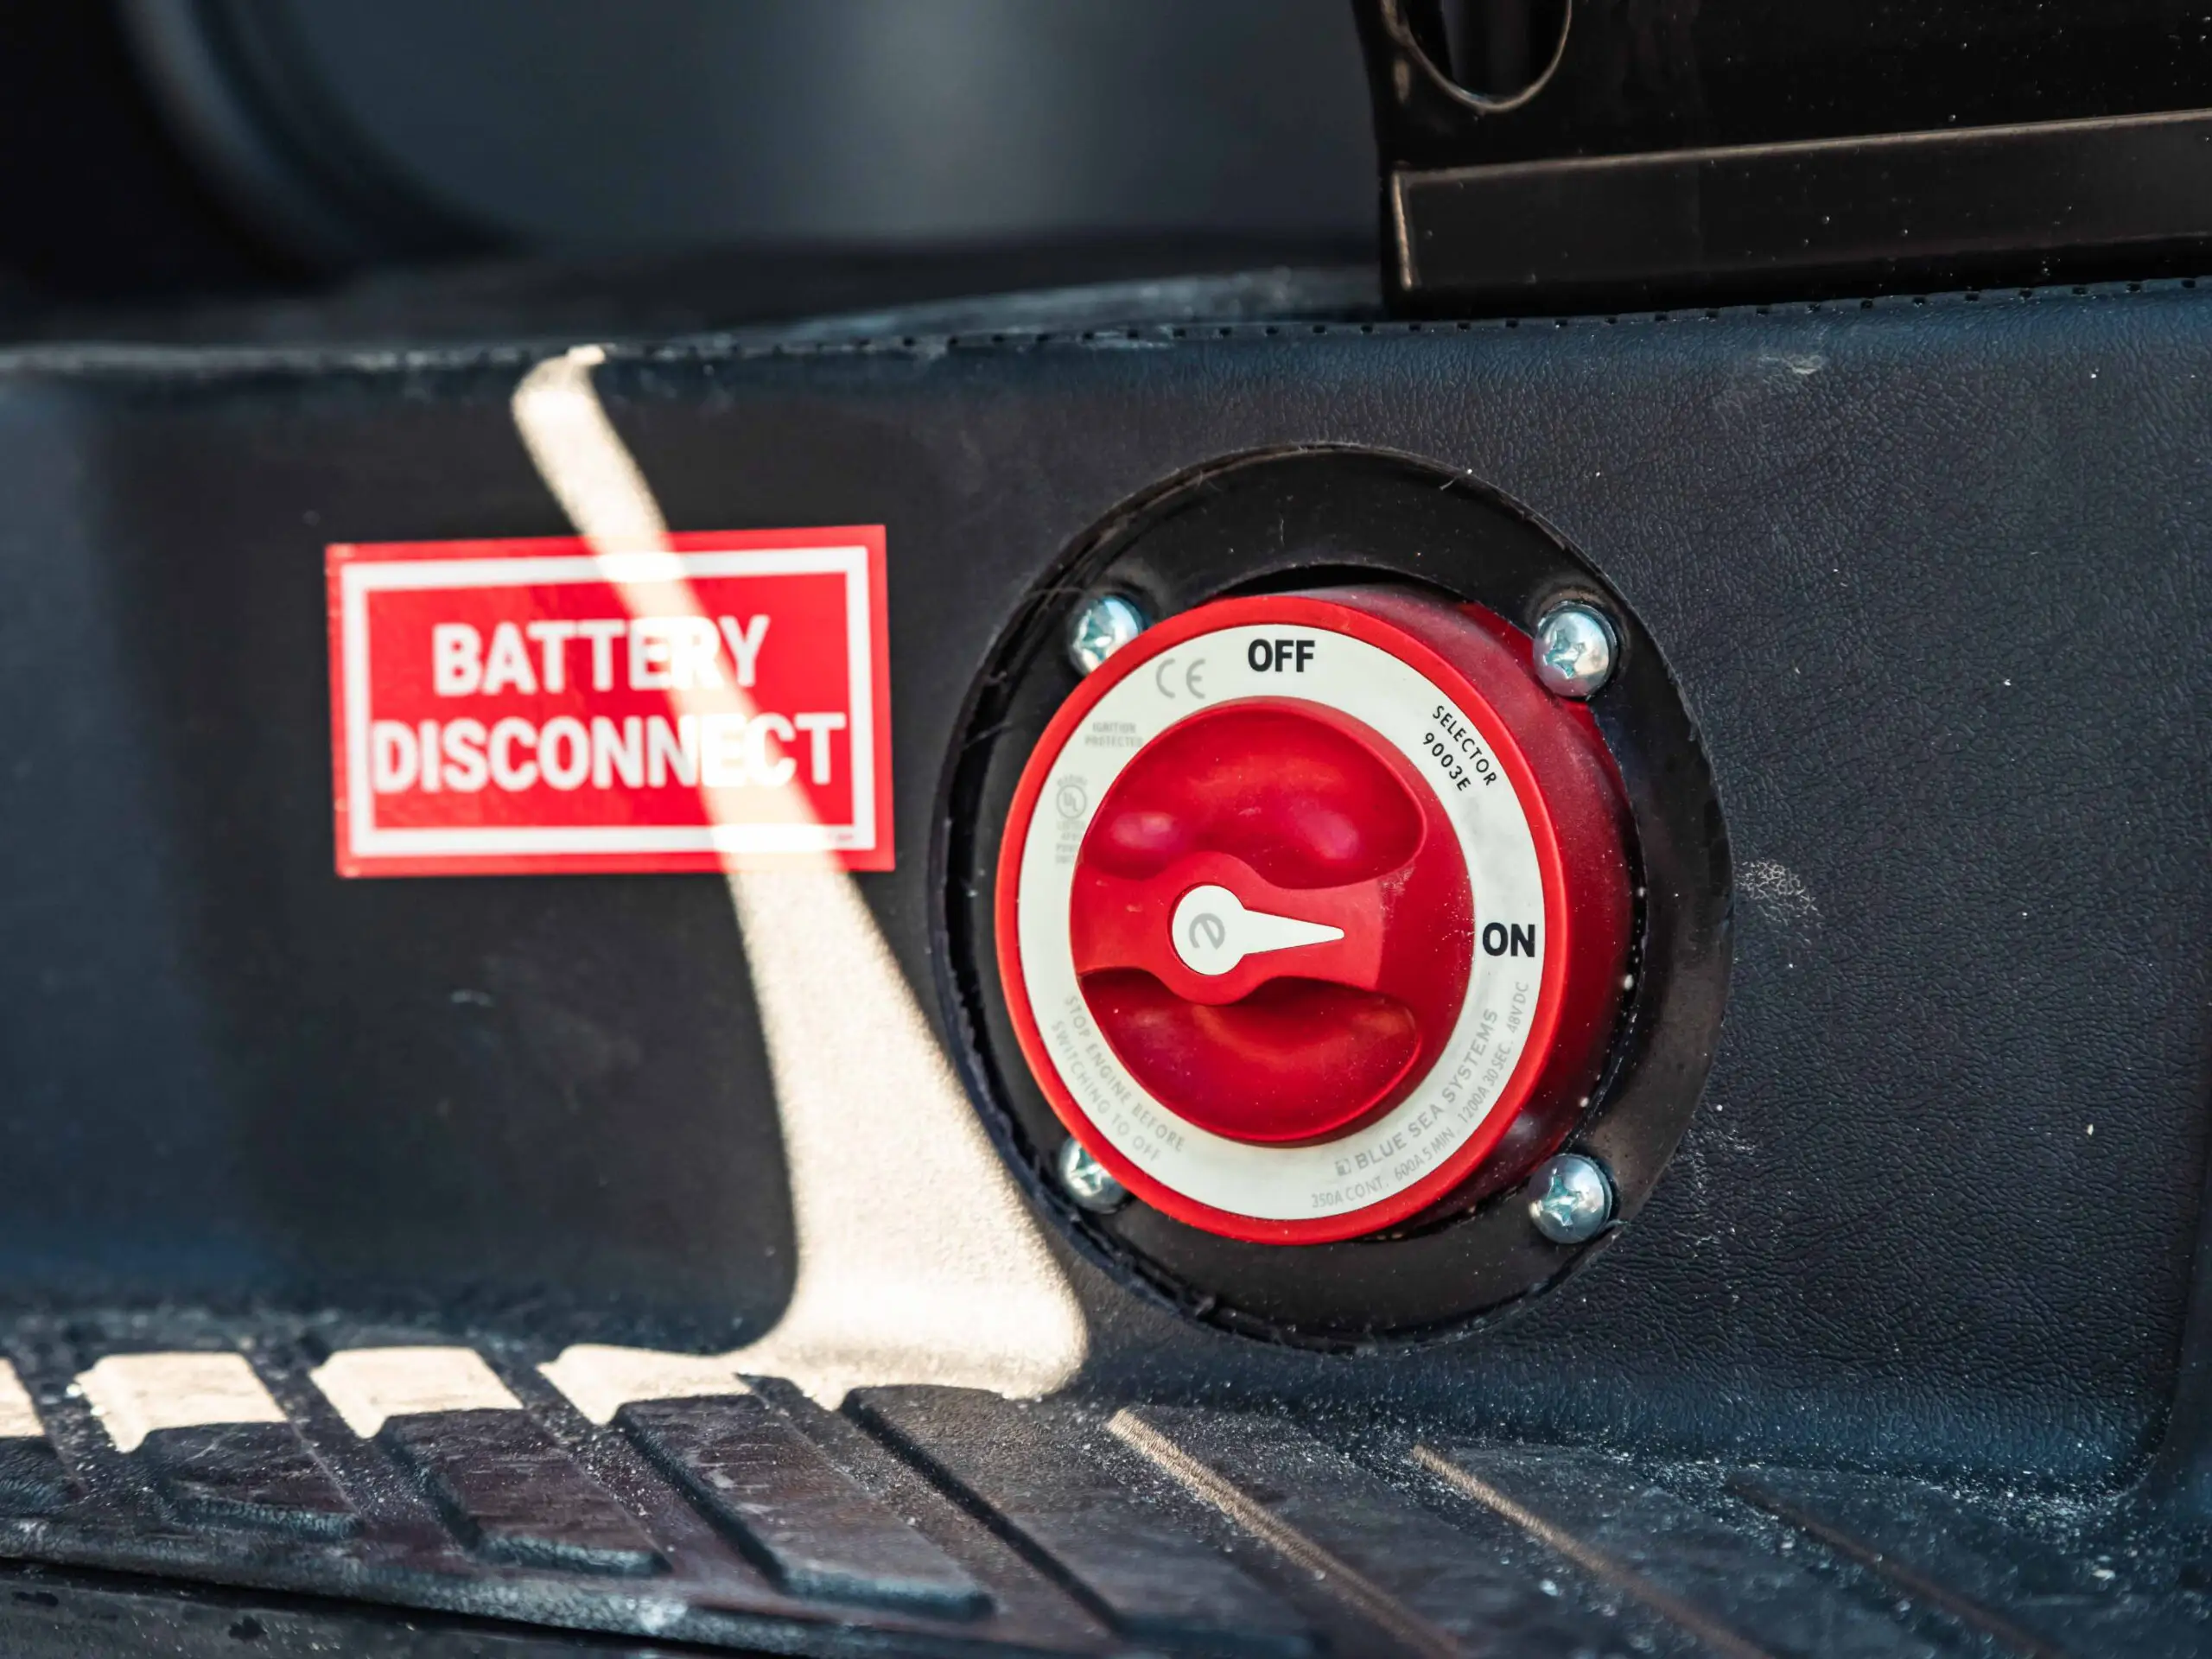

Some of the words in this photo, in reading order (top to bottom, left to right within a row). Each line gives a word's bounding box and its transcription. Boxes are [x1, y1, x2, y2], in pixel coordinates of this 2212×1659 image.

[433, 615, 770, 696] BATTERY
[1155, 658, 1205, 699] CE
[1248, 639, 1315, 672] OFF
[372, 713, 845, 792] DISCONNECT
[1092, 721, 1136, 734] IGNITION
[1421, 732, 1471, 791] 9003E
[1432, 705, 1497, 786] SELECTOR
[1482, 922, 1536, 957] ON
[1051, 1020, 1111, 1115] SWITCHING
[1112, 1113, 1130, 1137] TO
[1132, 1135, 1162, 1161] OFF
[1064, 995, 1091, 1037] STOP
[1085, 1043, 1132, 1103] ENGINE
[1132, 1103, 1185, 1152] BEFORE
[1354, 1132, 1408, 1171] BLUE
[1408, 1103, 1445, 1138] SEA
[1442, 1007, 1497, 1103] SYSTEMS
[1311, 1190, 1344, 1208] 350A
[1394, 1154, 1427, 1181] 600A
[1423, 1147, 1433, 1163] 5
[1457, 1085, 1490, 1124] 1200A
[1482, 1068, 1499, 1088] 30
